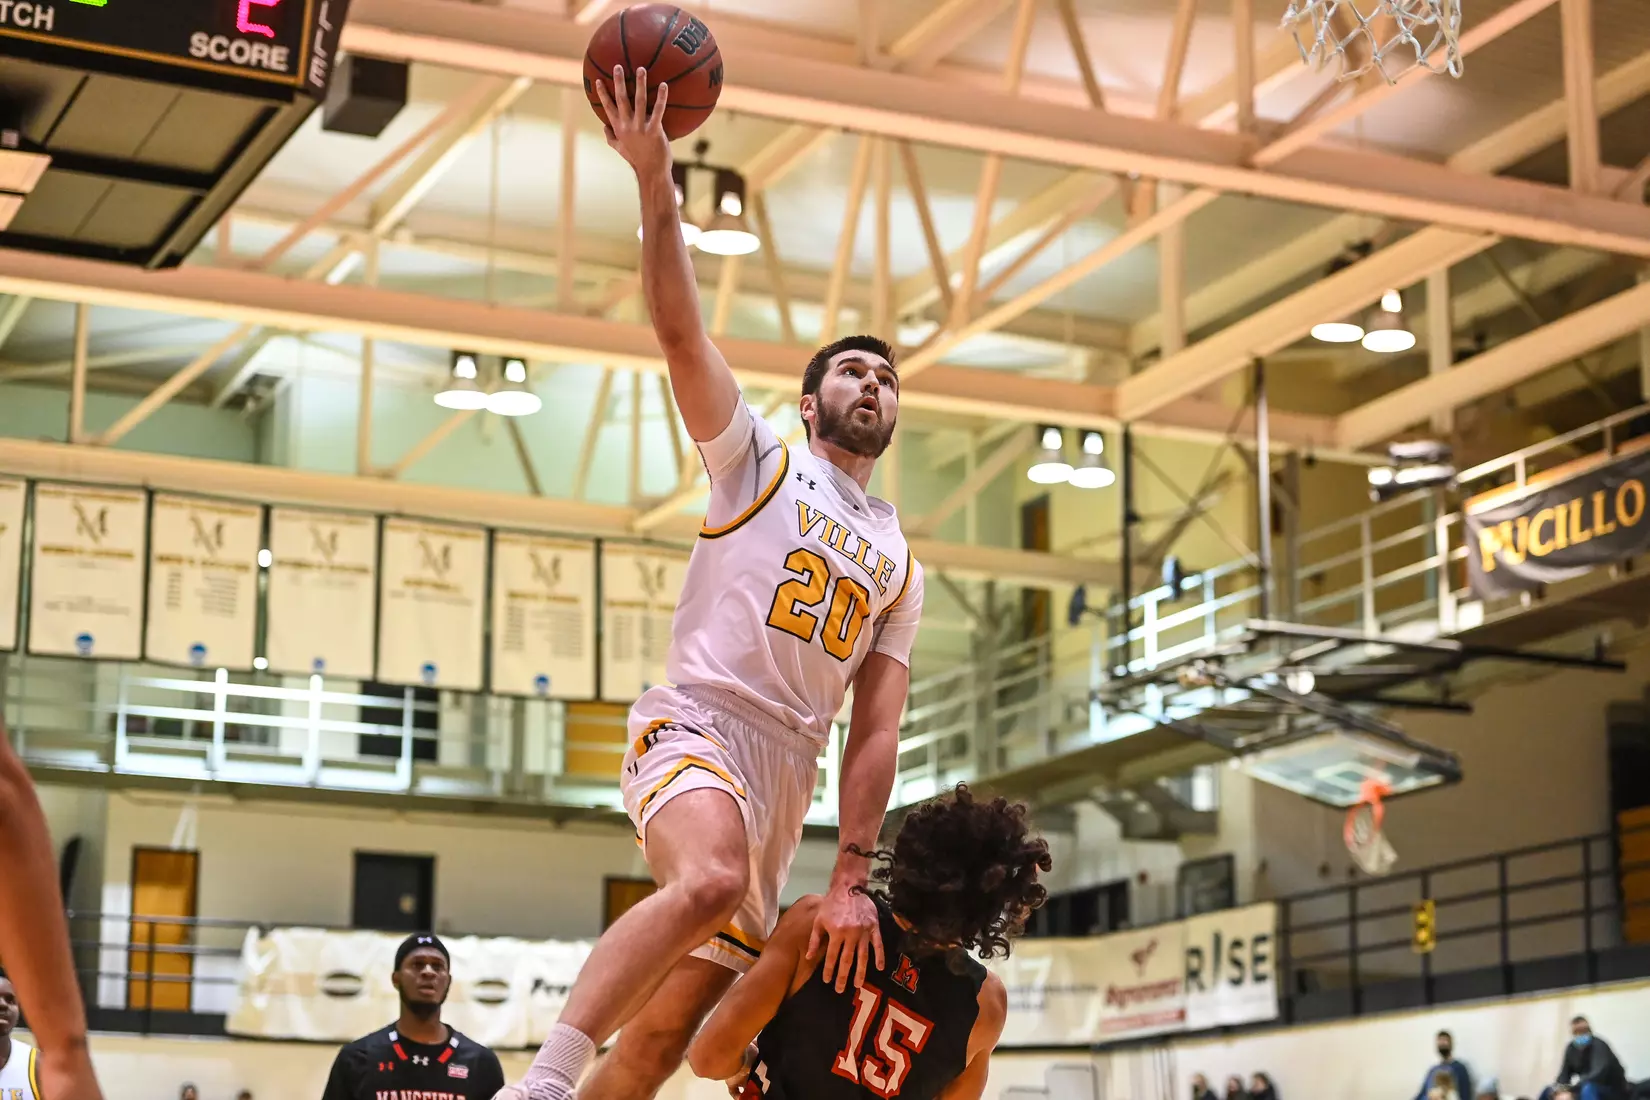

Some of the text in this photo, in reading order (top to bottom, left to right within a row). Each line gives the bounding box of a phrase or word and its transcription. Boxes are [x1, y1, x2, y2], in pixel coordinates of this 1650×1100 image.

[188, 31, 290, 72] SCORE
[795, 499, 897, 596] VILLE
[1479, 479, 1646, 573] PUCILLO
[766, 547, 870, 662] 20
[891, 952, 920, 994] M
[831, 980, 935, 1099] 15
